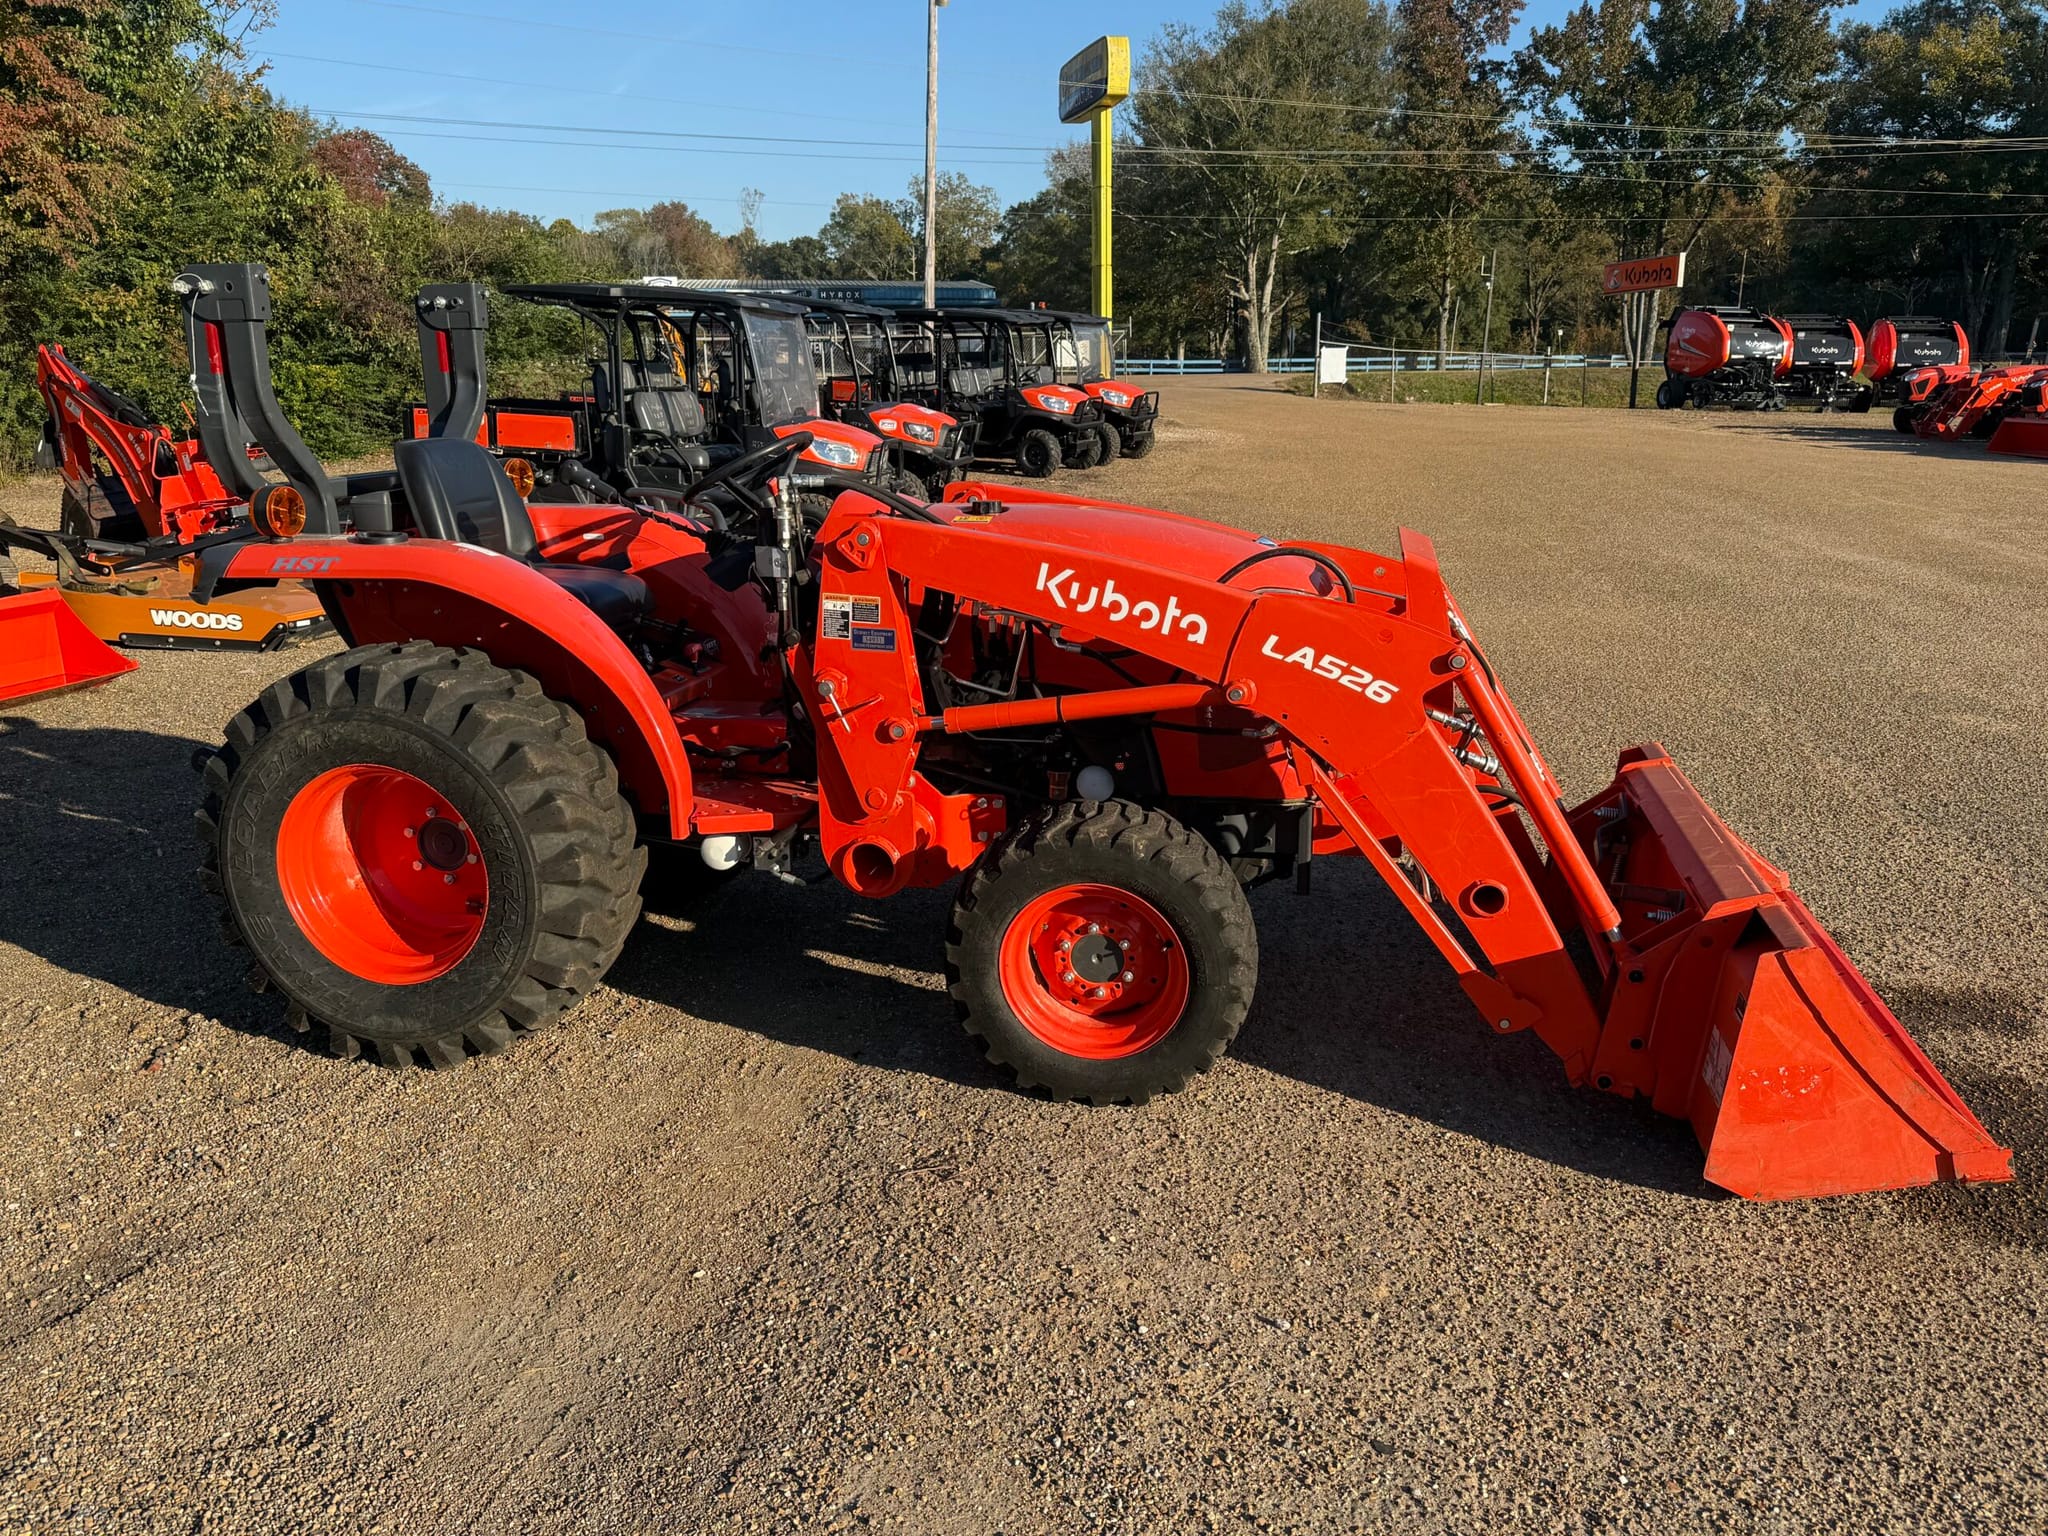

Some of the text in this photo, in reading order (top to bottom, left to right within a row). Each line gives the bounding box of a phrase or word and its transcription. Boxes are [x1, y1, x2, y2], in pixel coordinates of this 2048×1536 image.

[1624, 263, 1672, 285] Kubota
[820, 291, 860, 299] HYROX
[1811, 346, 1839, 354] Kubota
[1914, 348, 1942, 356] Kubota
[269, 556, 341, 573] HST
[1035, 562, 1209, 645] Kubota
[150, 609, 243, 631] WOODS
[1261, 634, 1400, 704] LA526
[485, 823, 522, 969] TITAN
